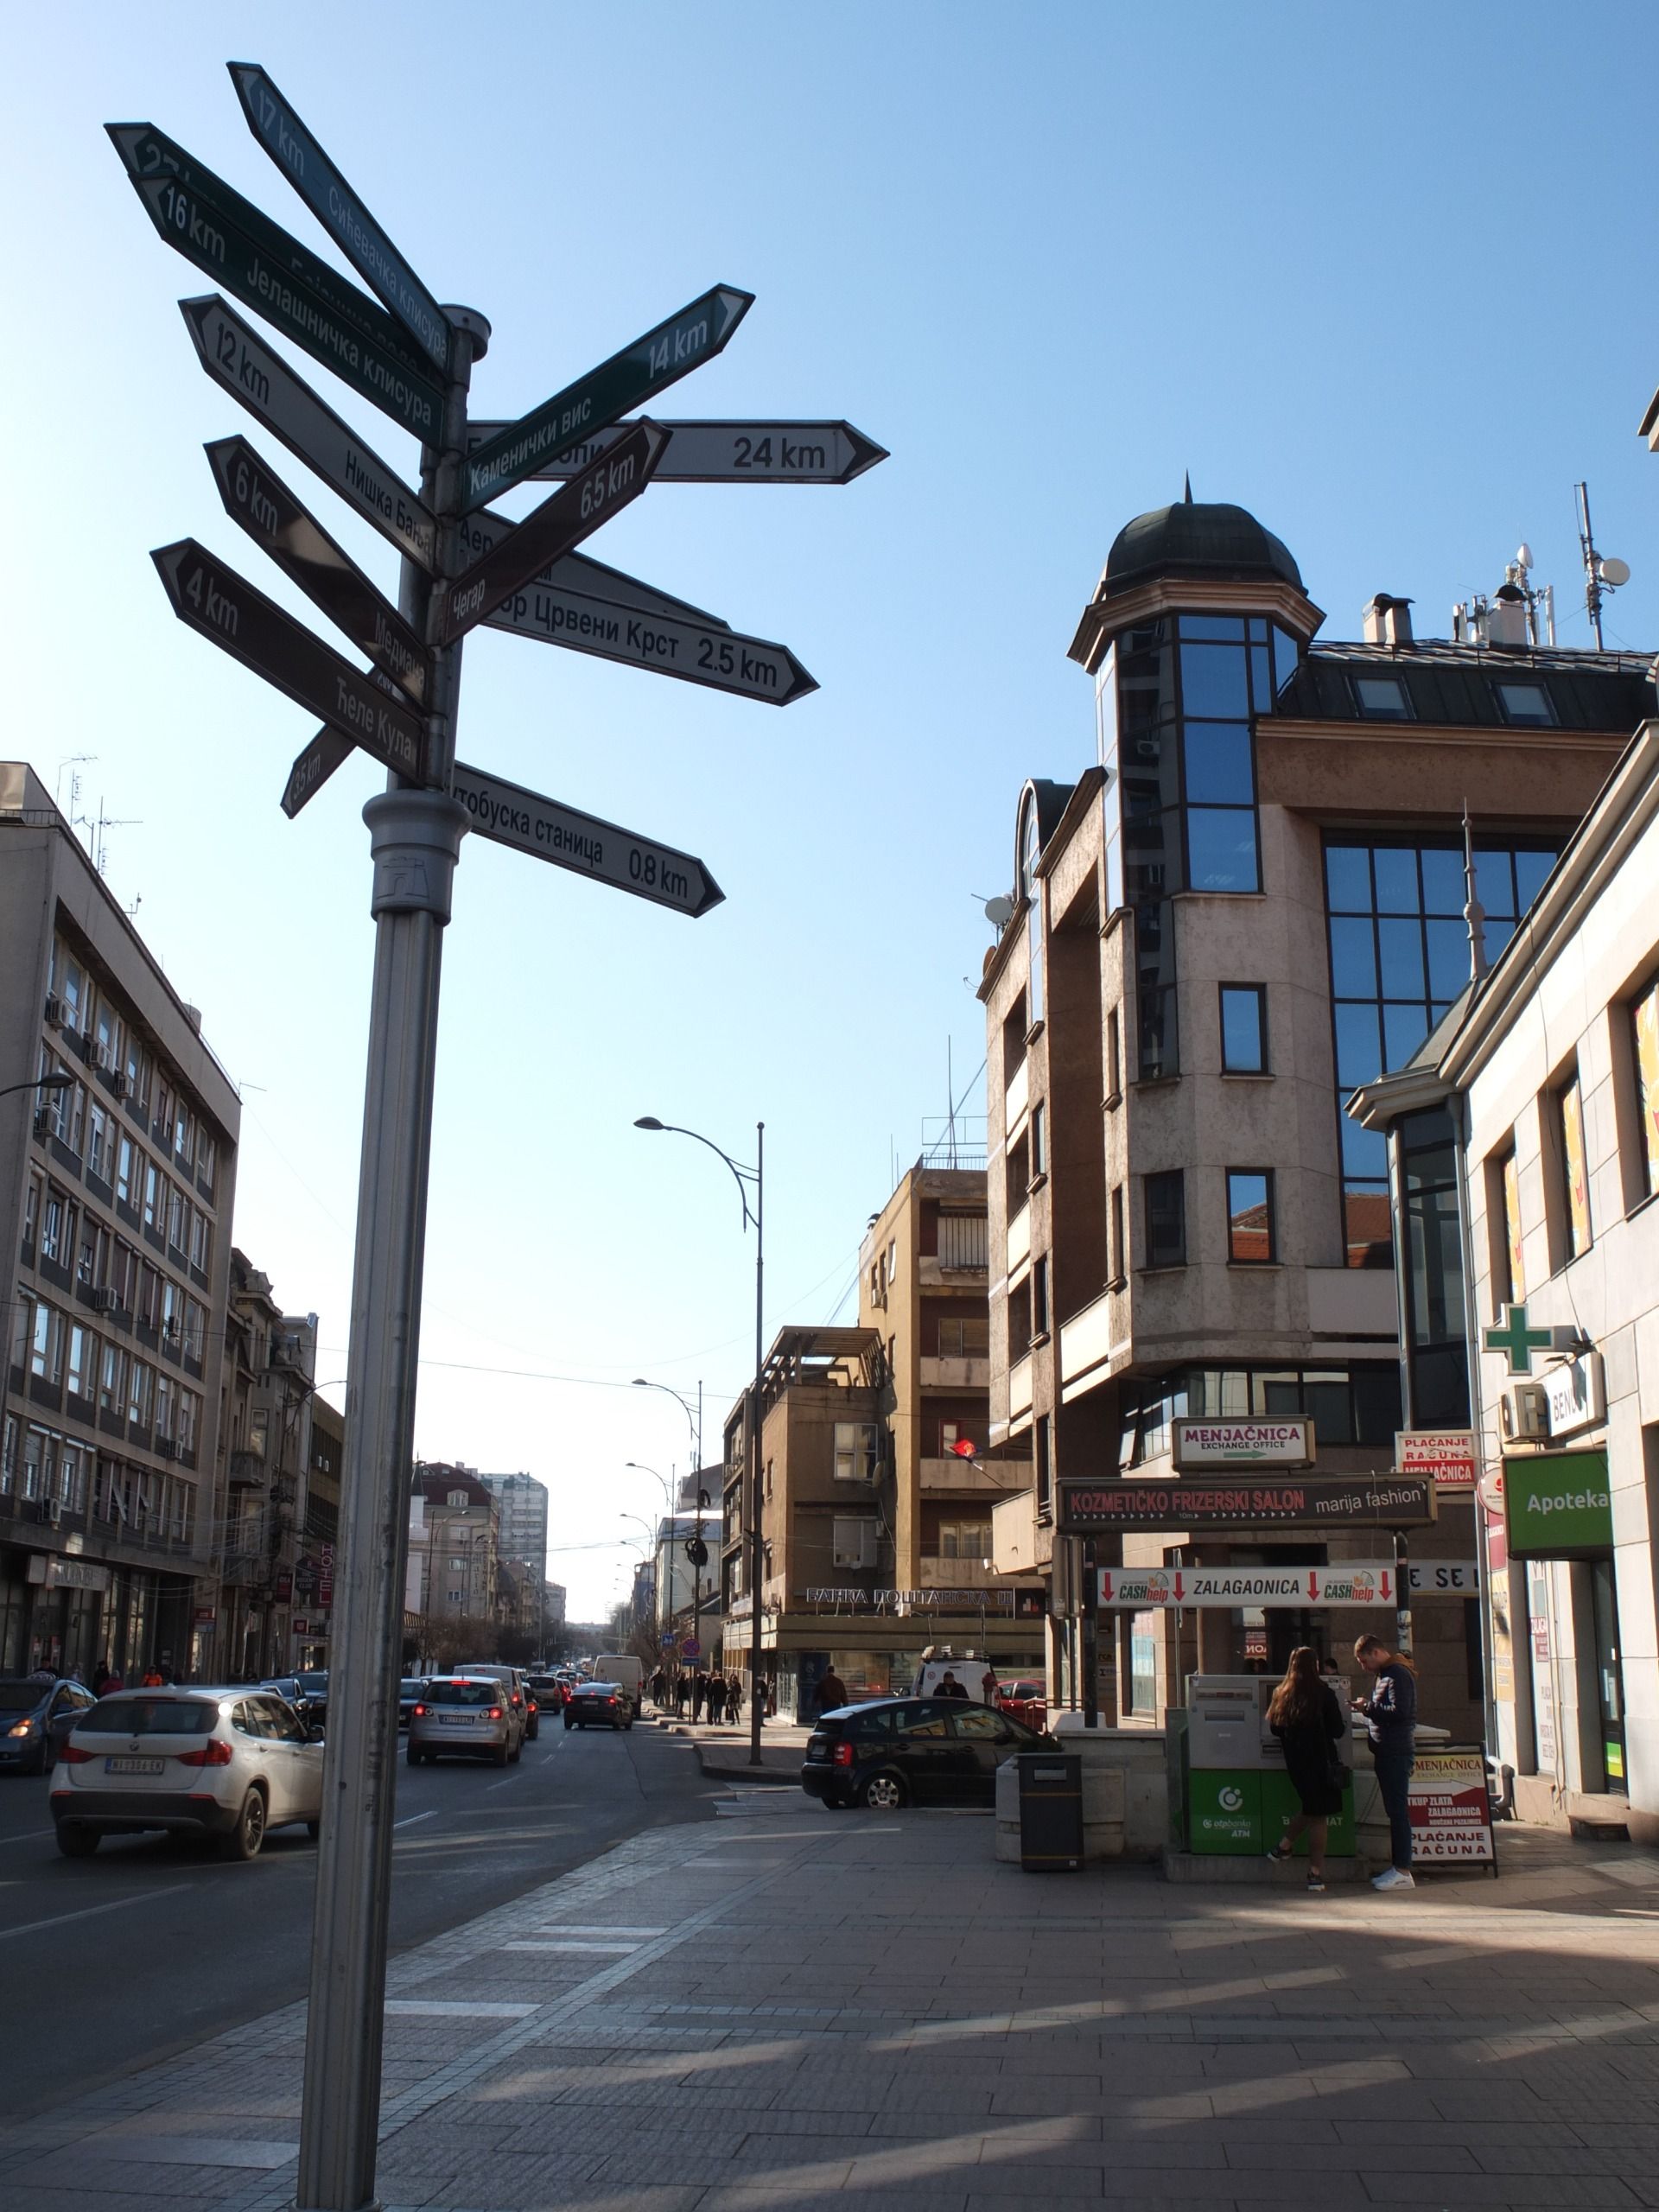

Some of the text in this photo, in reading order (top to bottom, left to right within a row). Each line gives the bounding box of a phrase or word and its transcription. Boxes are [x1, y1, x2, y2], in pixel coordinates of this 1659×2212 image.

[259, 90, 304, 177] 17 km
[167, 186, 188, 229] 16
[189, 201, 226, 263] km
[328, 187, 397, 292] Сићевачка
[400, 288, 448, 359] клисура
[216, 324, 270, 404] 12 km
[246, 259, 359, 369] Јелашничка
[364, 353, 432, 429] клисура
[649, 318, 708, 379] 14 km
[470, 397, 592, 497] Каменички вис
[734, 436, 826, 468] 24 km
[236, 461, 278, 537] 6 km
[346, 448, 432, 558] Нишка Бања
[581, 480, 605, 518] 6.5
[608, 452, 635, 498] km
[186, 567, 239, 637] 4 km
[453, 578, 486, 620] Чегар
[535, 594, 619, 643] Црвени
[626, 620, 679, 659] Крст
[698, 639, 777, 689] 2.5 km
[336, 676, 413, 762] Ћеле Кула
[307, 753, 321, 784] km
[535, 820, 603, 867] станица
[628, 848, 688, 899] 0.8 km
[1185, 1426, 1300, 1443] MENJAČNICA
[1201, 1440, 1286, 1450] EXCHANGE OFFICE
[1071, 1489, 1305, 1513] KOZMETIČKO FRIZERSKI SALON
[1316, 1488, 1421, 1514] marija fashion
[1527, 1489, 1610, 1516] Apoteka
[319, 1541, 332, 1603] HOTEL
[1194, 1580, 1300, 1596] ZALAGAONICA
[1435, 1567, 1465, 1588] SE
[807, 1588, 868, 1604] БАНКА
[874, 1589, 990, 1605] ПОШТАНСКА
[1415, 1758, 1482, 1772] MENJAČNICA
[1428, 1806, 1481, 1816] ZALAGAONICA
[1429, 1796, 1452, 1806] ZLATA
[1231, 1829, 1250, 1839] ATM
